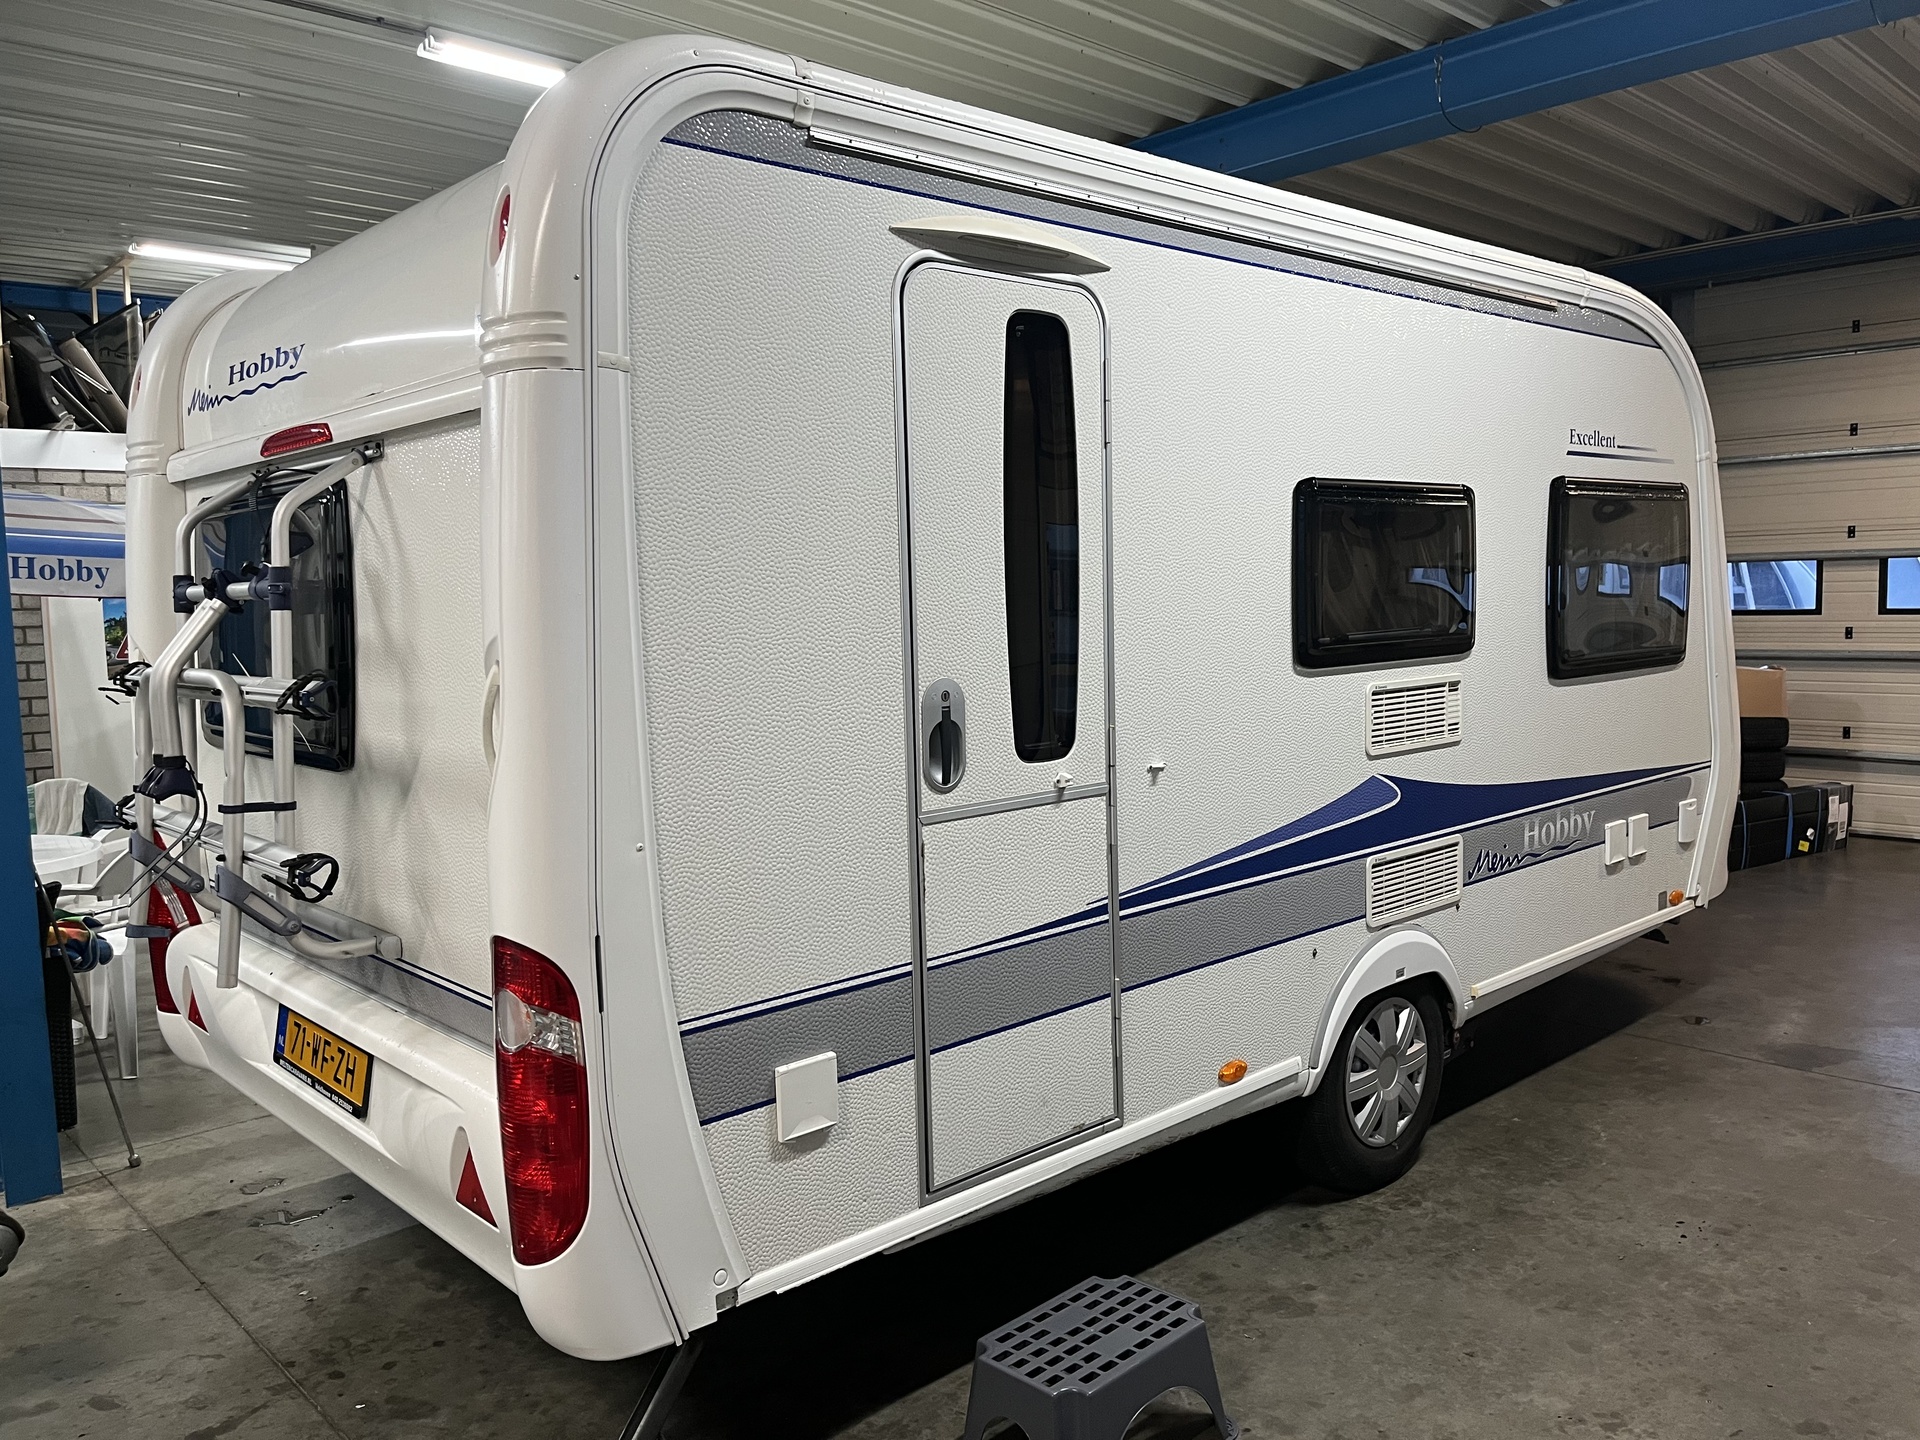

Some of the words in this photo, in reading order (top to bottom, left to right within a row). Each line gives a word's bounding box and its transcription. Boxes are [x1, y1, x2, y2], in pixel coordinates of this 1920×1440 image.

[187, 384, 221, 416] Mein
[228, 343, 305, 386] Hobby
[1569, 428, 1616, 449] Excellent
[9, 556, 110, 589] Hobby
[1467, 843, 1522, 881] Mein
[1523, 806, 1596, 851] Hobby
[278, 1034, 284, 1047] NL
[290, 1020, 357, 1093] 71-WF-ZH
